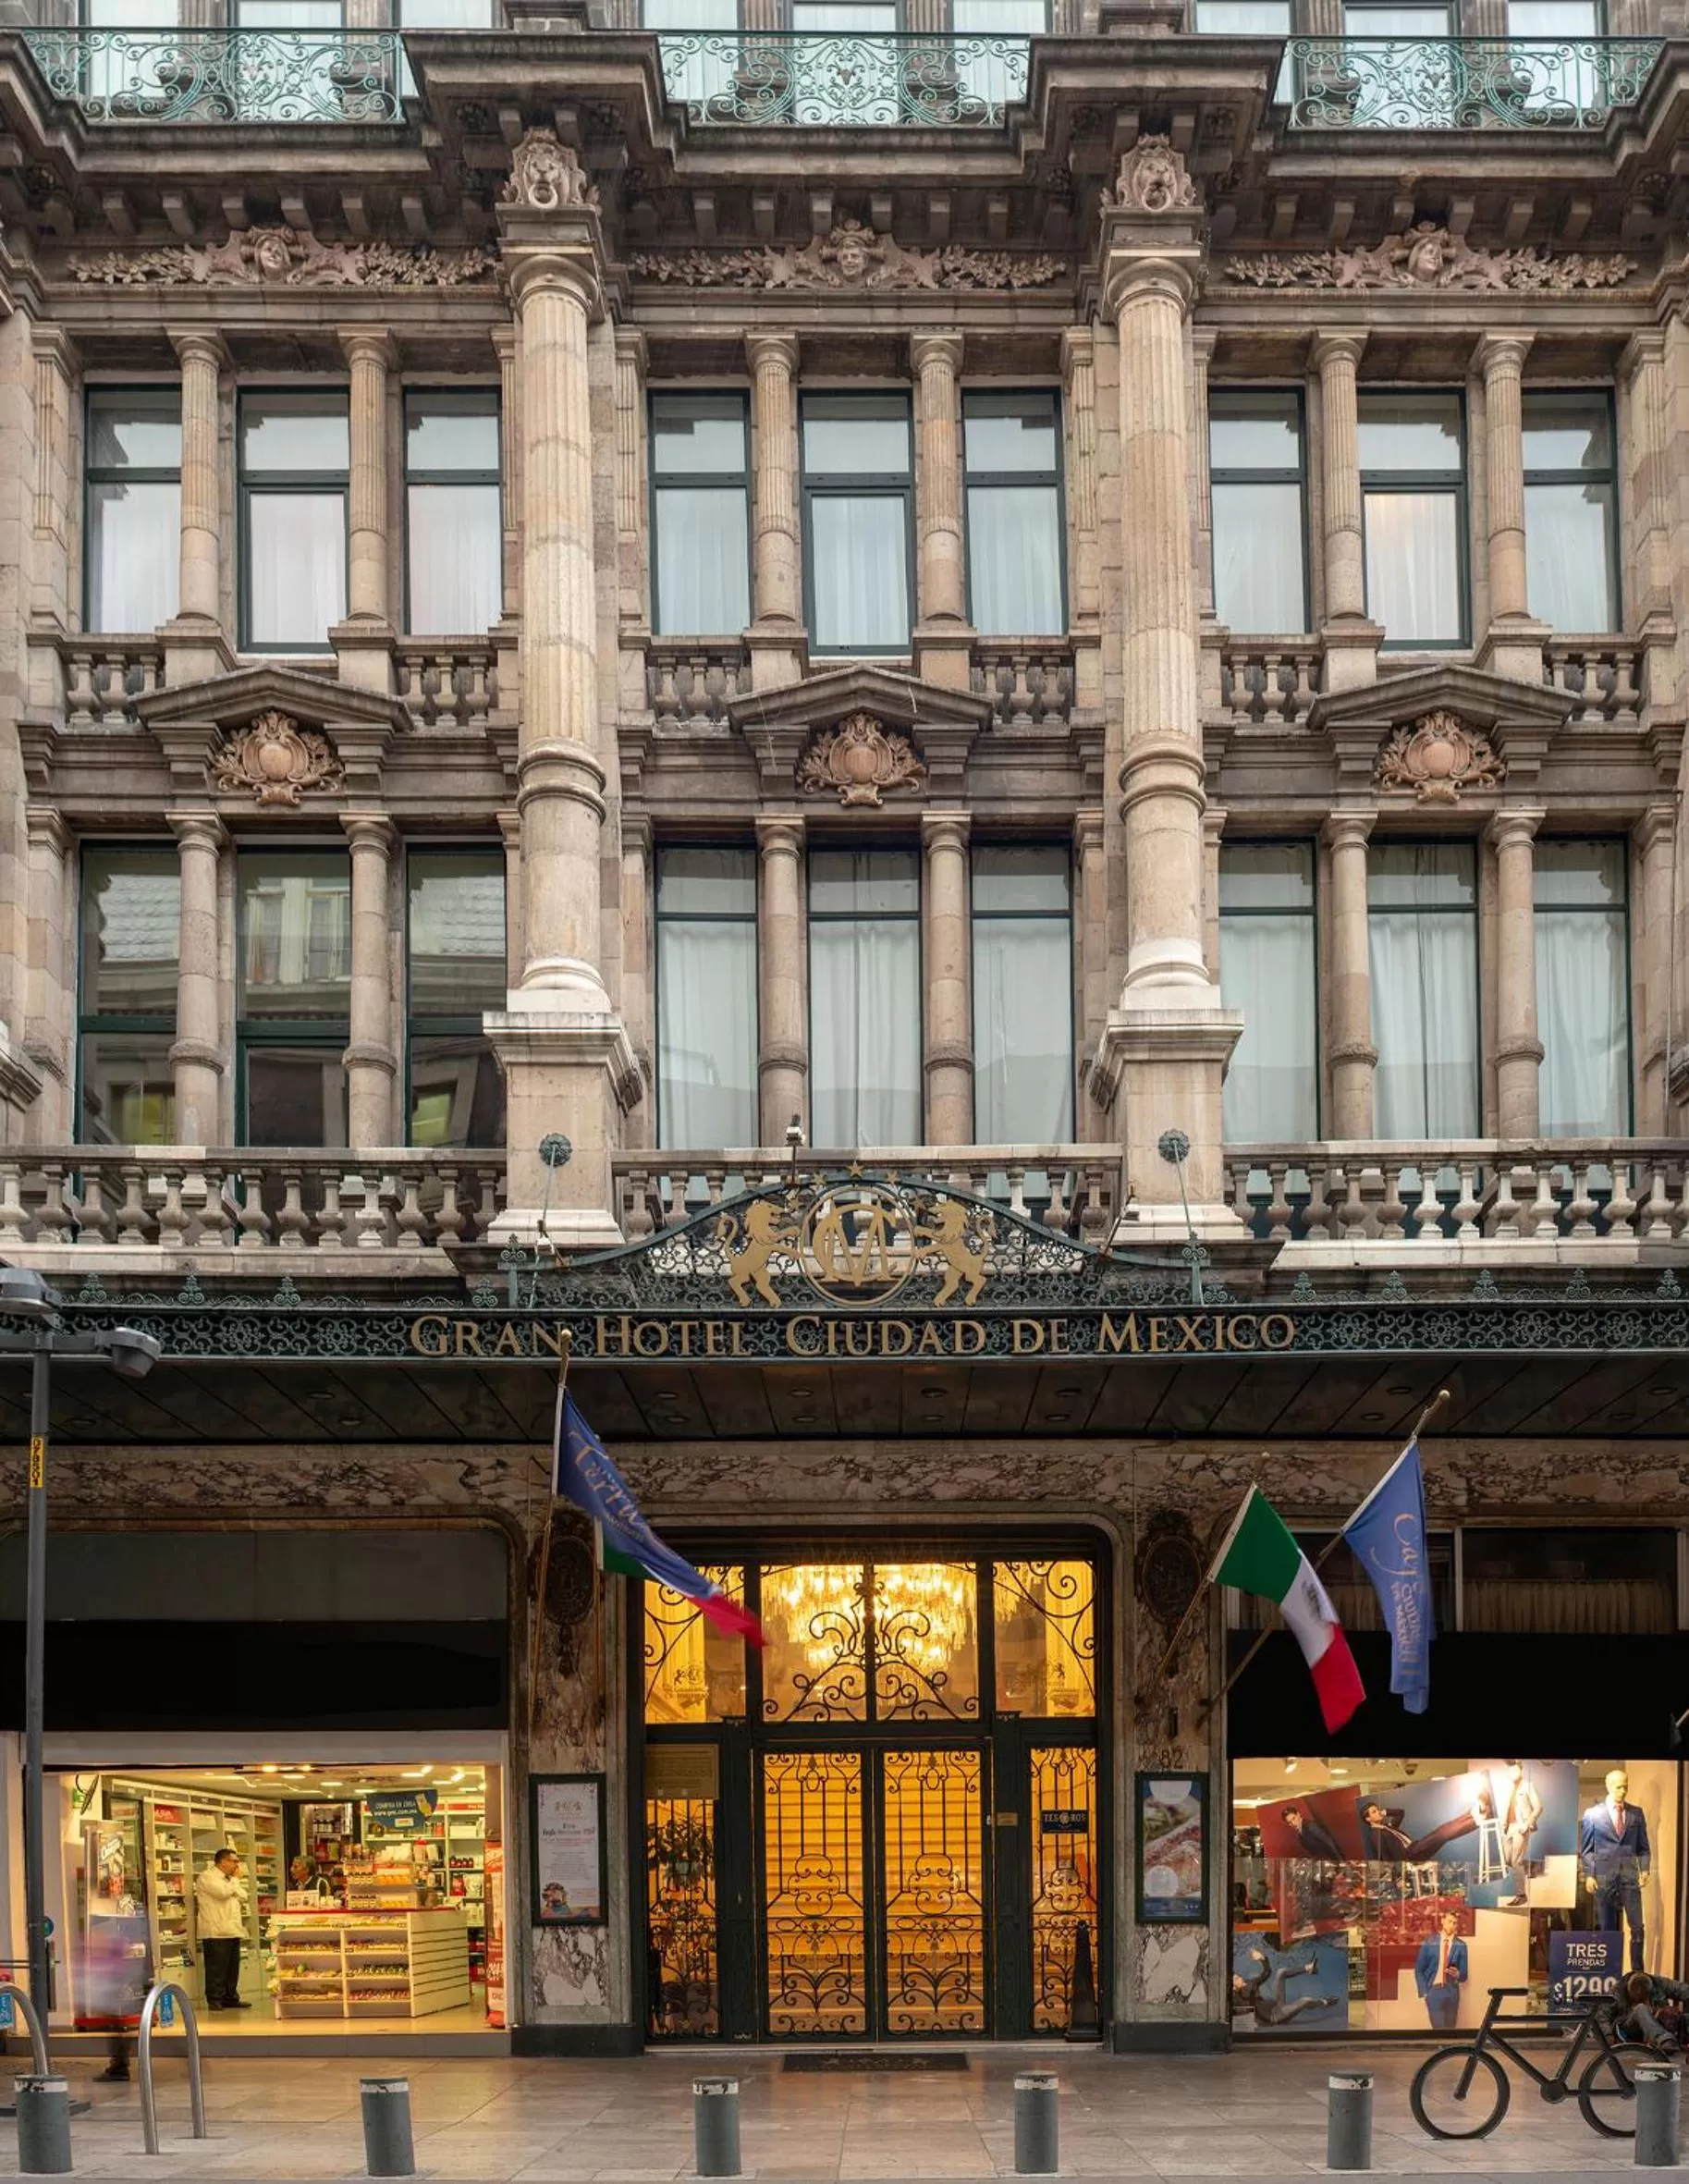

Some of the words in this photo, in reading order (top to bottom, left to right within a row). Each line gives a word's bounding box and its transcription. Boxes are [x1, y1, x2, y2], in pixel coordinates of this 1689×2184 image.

[410, 1315, 561, 1357] GRAN
[594, 1314, 753, 1356] HOTEL
[787, 1315, 985, 1356] CIUDAD
[1010, 1318, 1069, 1354] DE
[1095, 1311, 1295, 1353] MEXICO
[1566, 1944, 1608, 1957] TRES
[1567, 1957, 1606, 1967] PRENDAS
